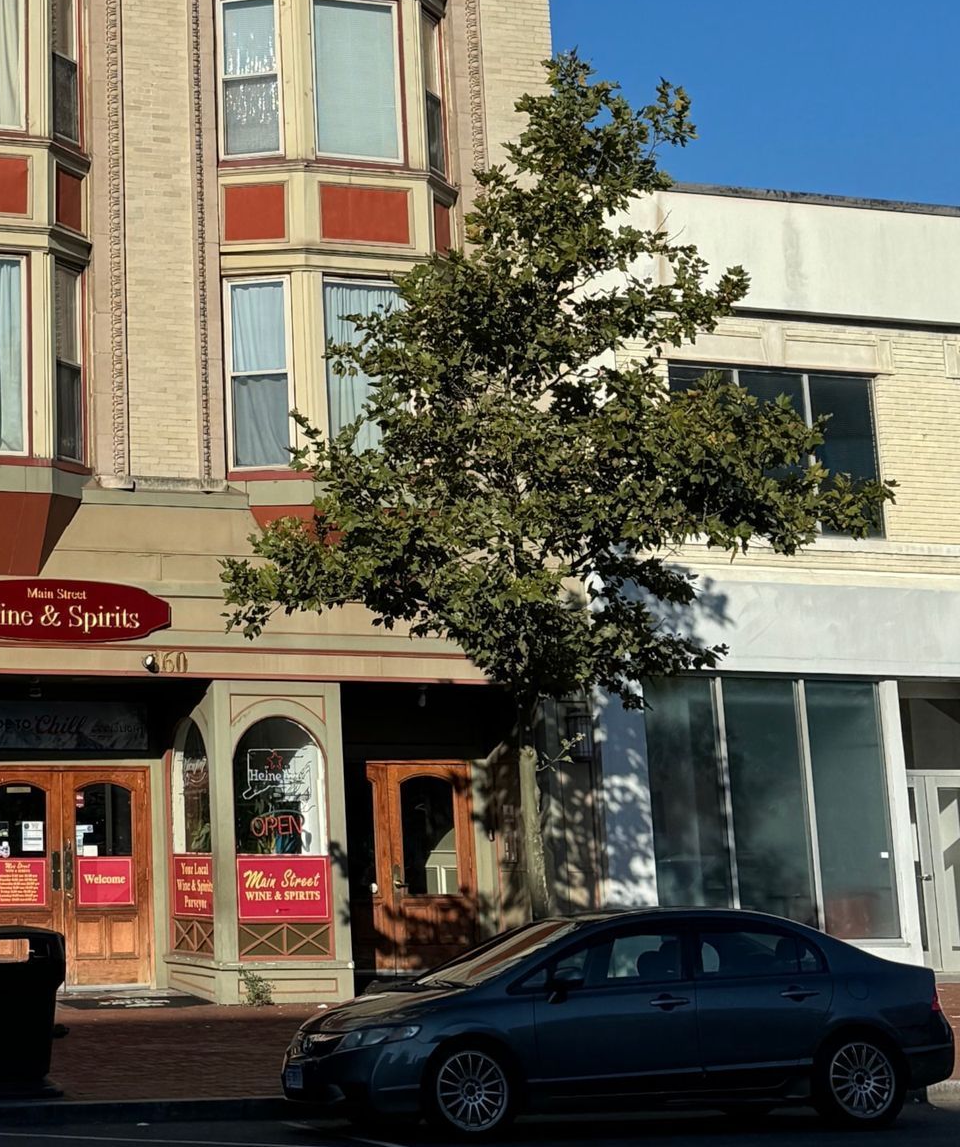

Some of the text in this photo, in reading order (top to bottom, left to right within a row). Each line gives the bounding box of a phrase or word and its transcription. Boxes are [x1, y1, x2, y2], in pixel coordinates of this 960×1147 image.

[27, 588, 88, 600] Main Street
[40, 604, 62, 627] &
[68, 605, 141, 634] Spirits
[15, 718, 31, 731] TO
[35, 714, 89, 735] Chill
[251, 815, 303, 837] OPEN
[180, 862, 209, 876] Your Local
[83, 874, 126, 884] Welcome
[176, 878, 213, 895] Wine & Spirits
[243, 868, 321, 889] Main Street
[245, 890, 321, 901] WINE & SPIRITS
